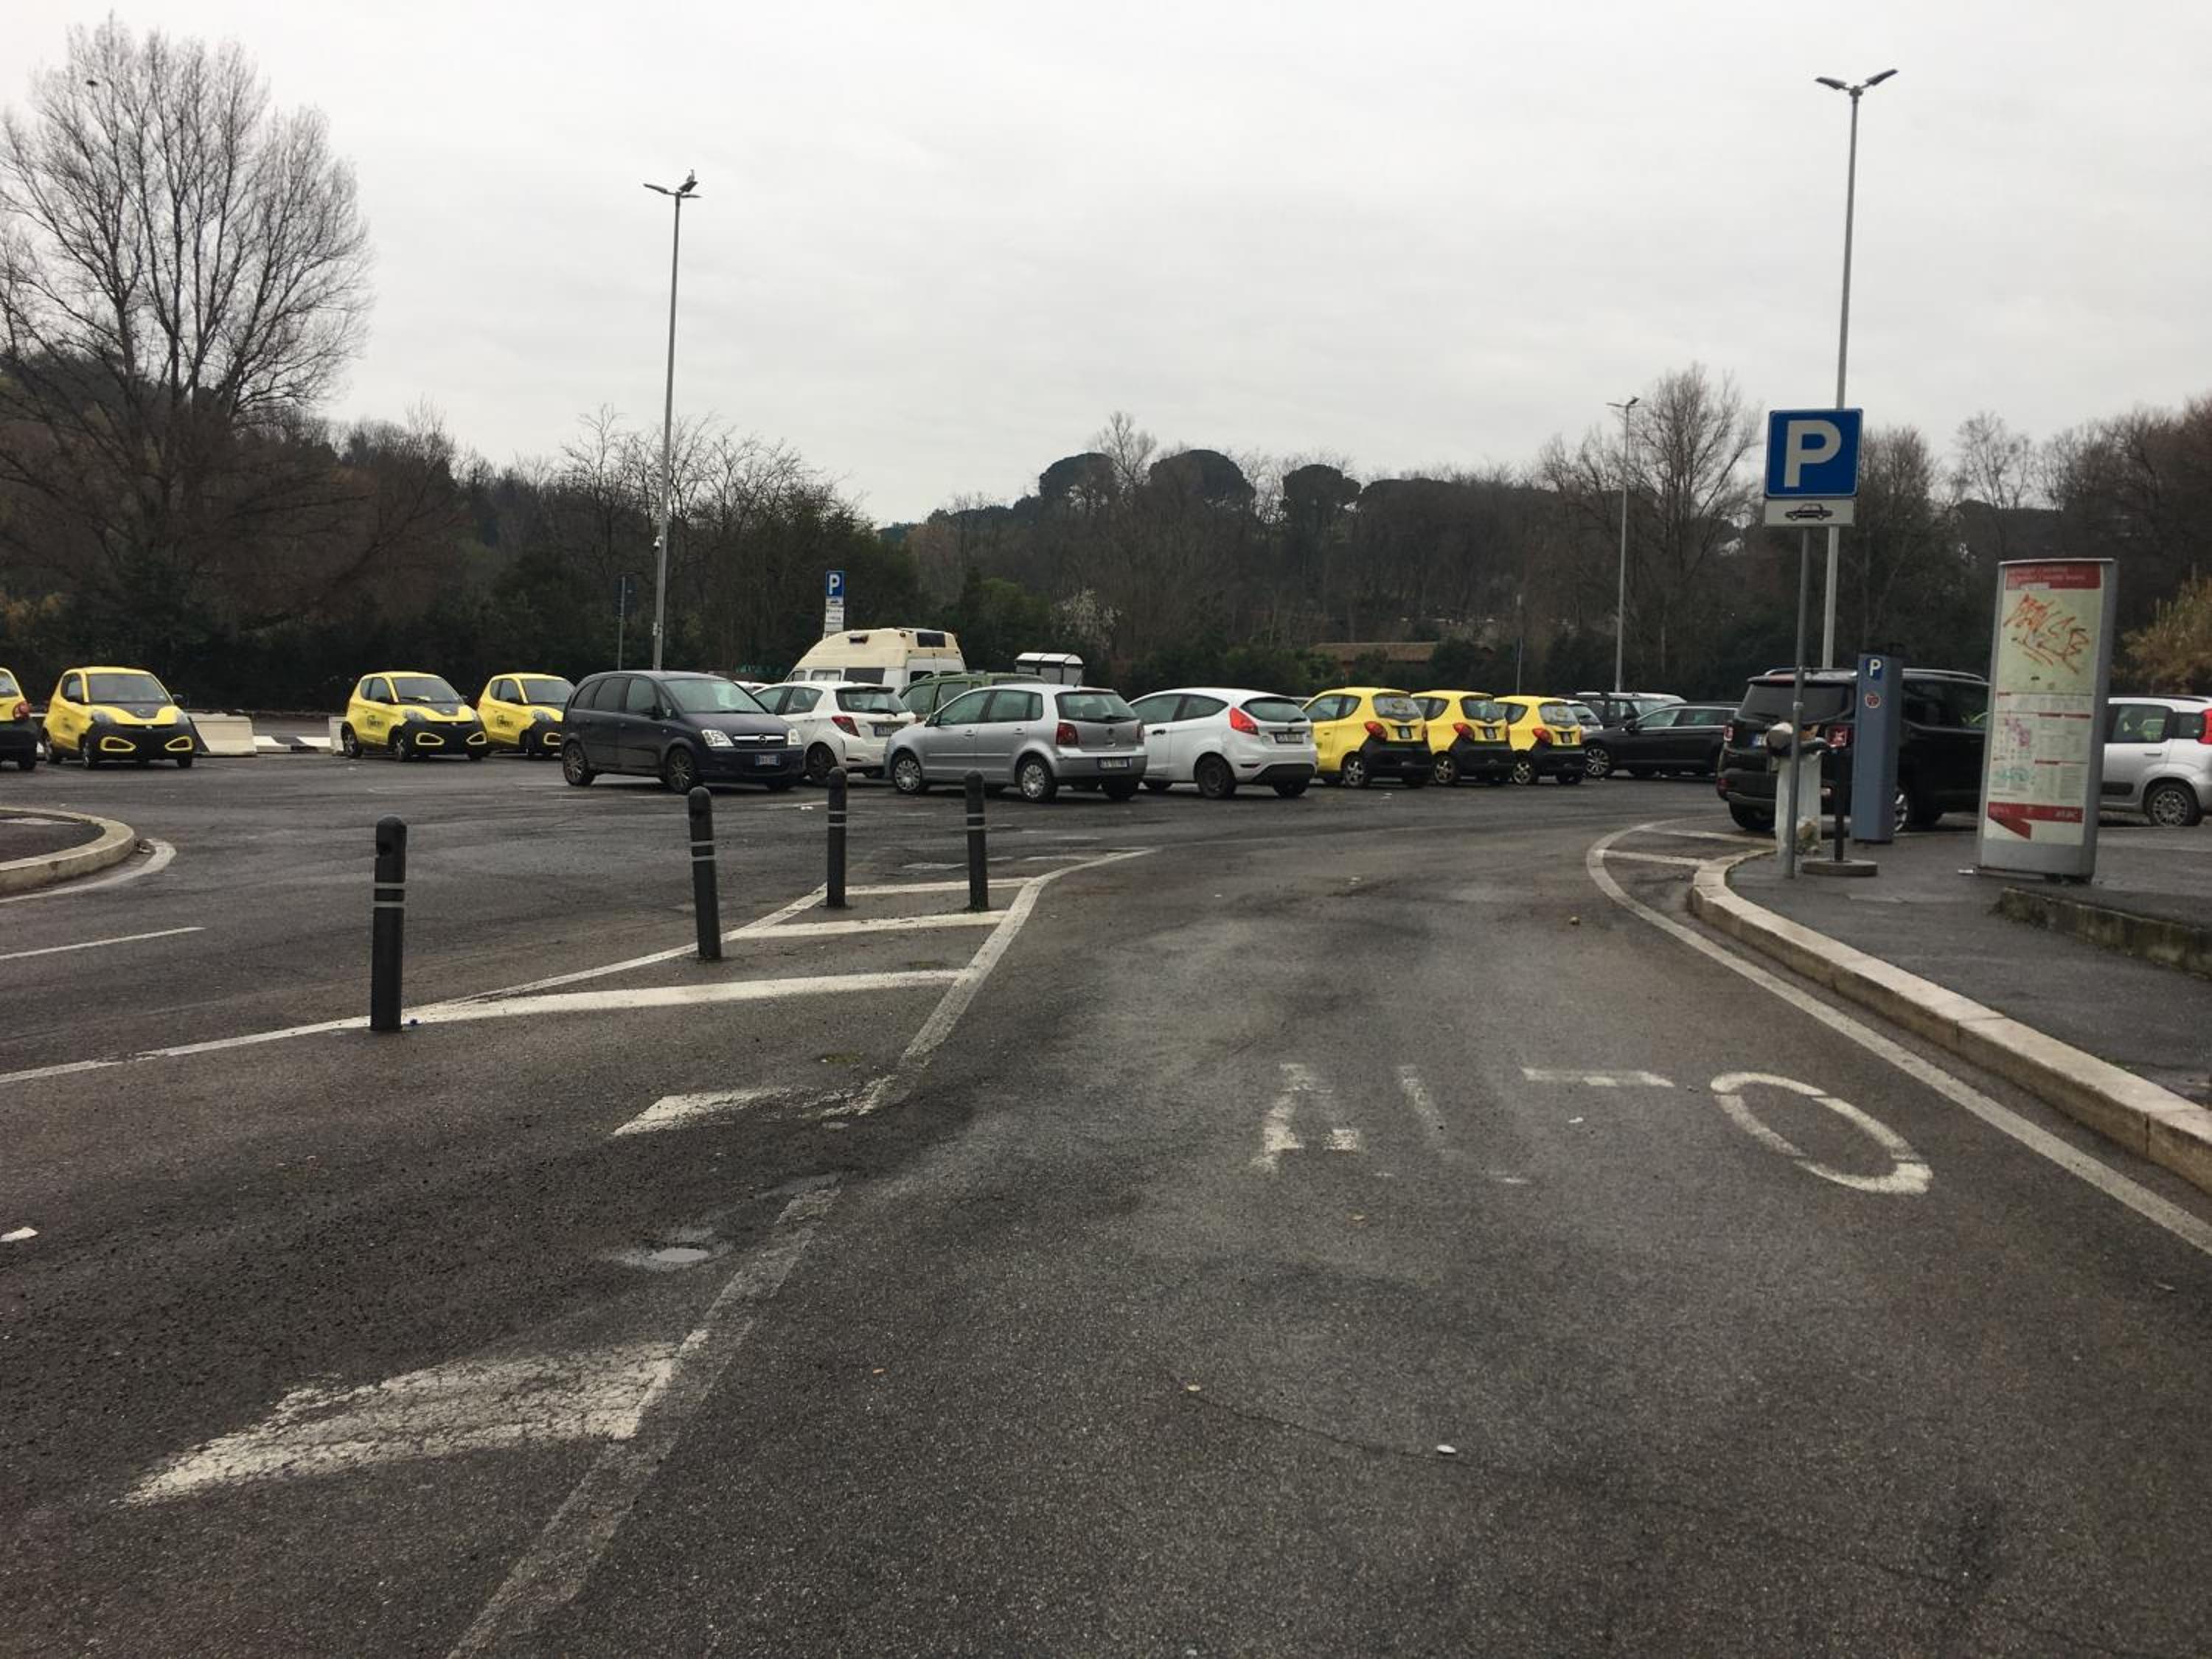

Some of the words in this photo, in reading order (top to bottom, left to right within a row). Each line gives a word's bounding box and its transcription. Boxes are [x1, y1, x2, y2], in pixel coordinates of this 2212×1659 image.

[1784, 420, 1841, 487] P
[829, 574, 841, 595] P
[1869, 659, 1882, 676] P
